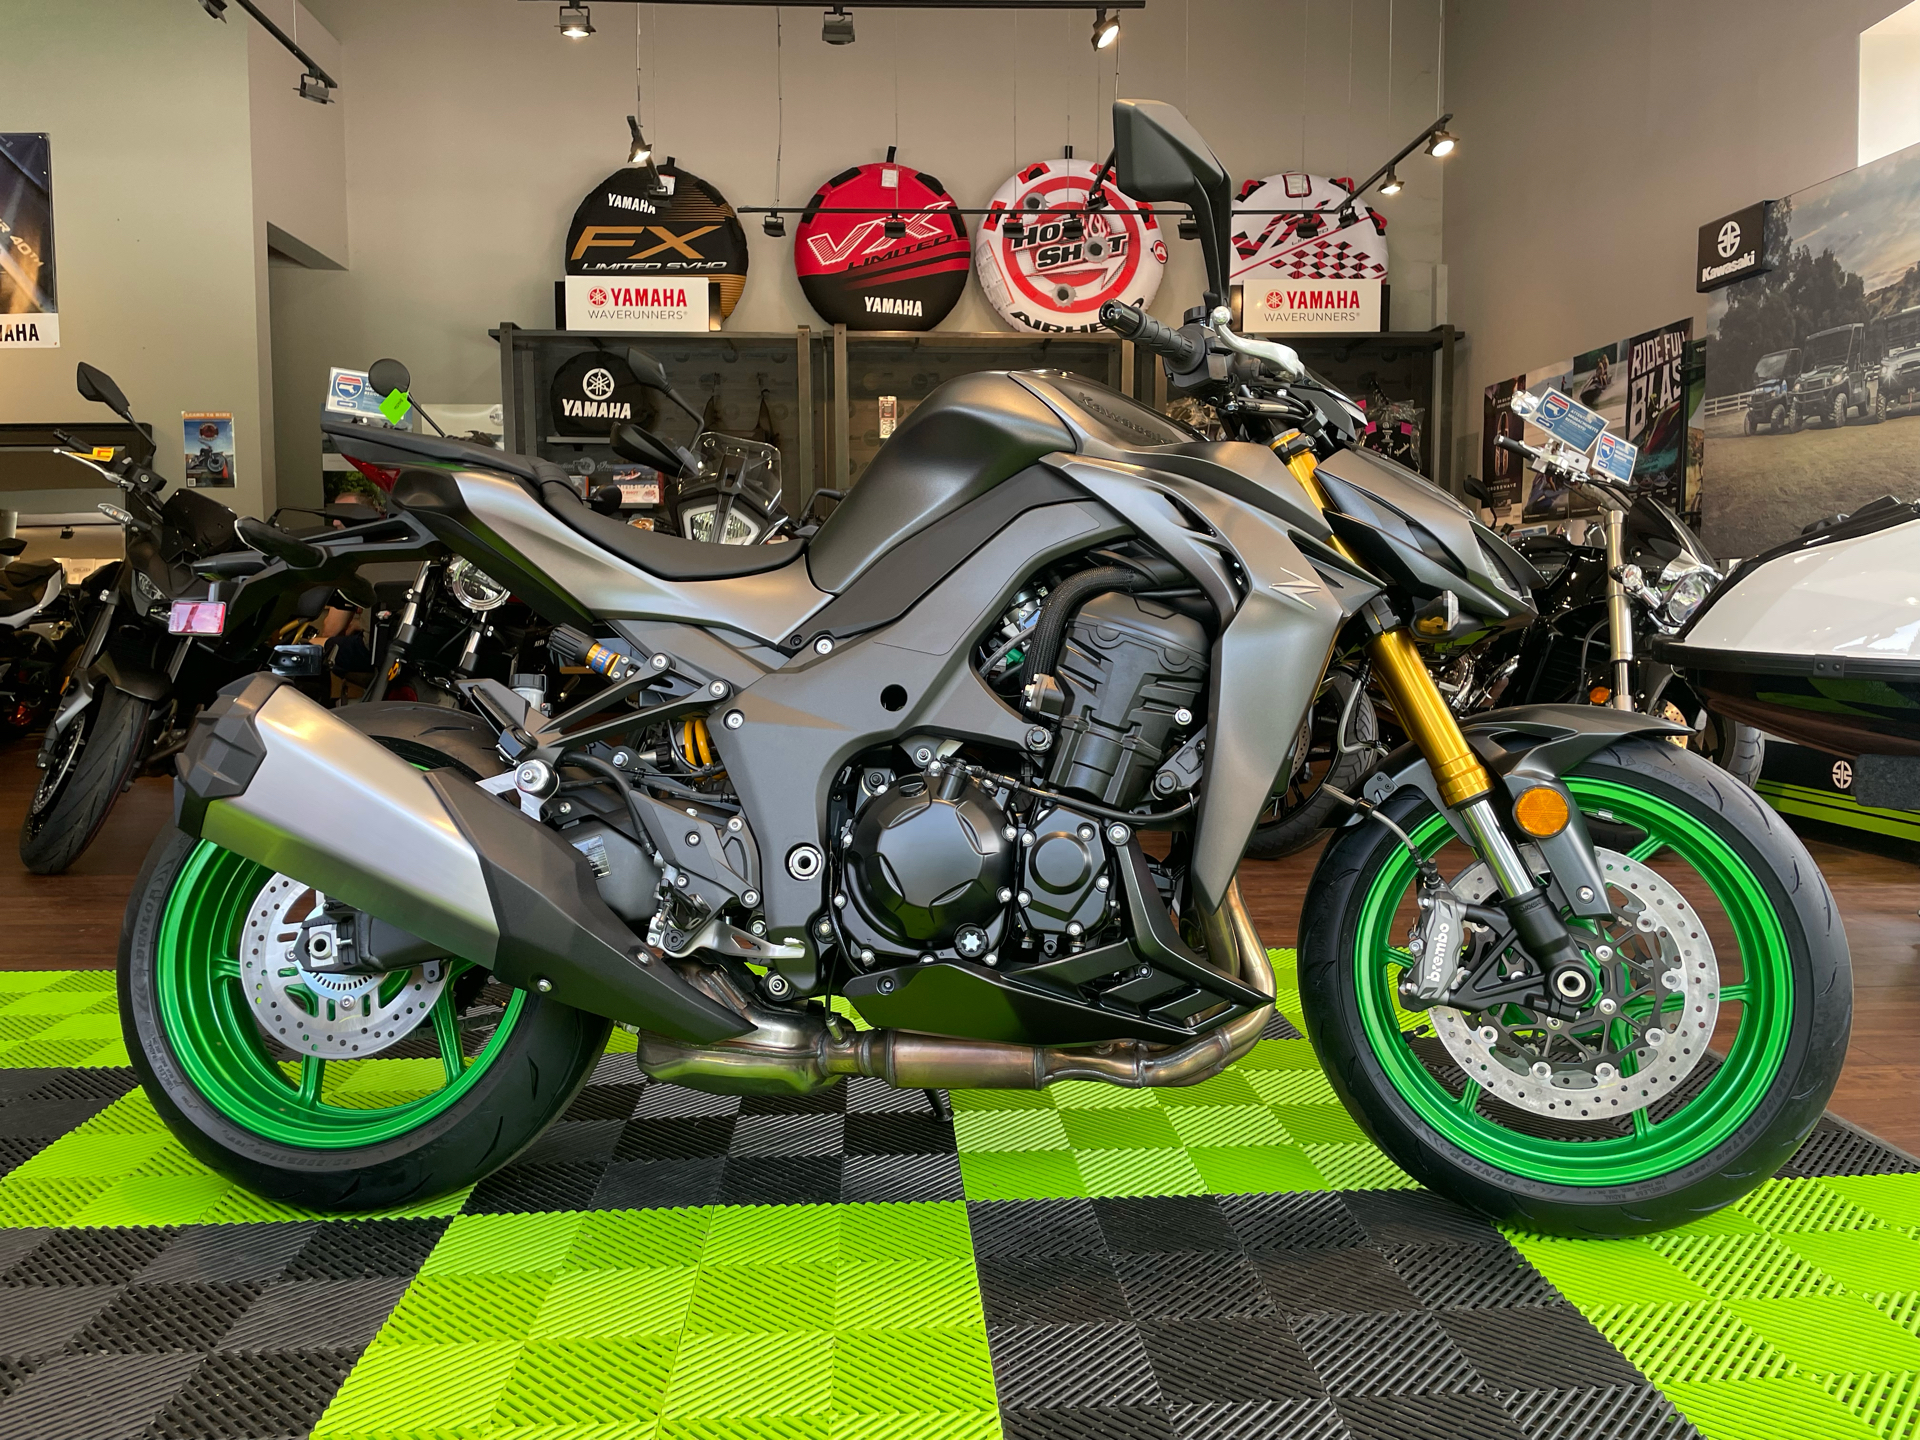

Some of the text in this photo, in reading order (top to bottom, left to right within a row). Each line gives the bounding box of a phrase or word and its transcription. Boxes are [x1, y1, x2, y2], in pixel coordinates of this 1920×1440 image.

[607, 193, 656, 214] YAMAHA
[570, 225, 722, 260] FX
[1012, 219, 1084, 249] HO
[582, 261, 728, 271] LIMITED SVHO
[848, 234, 952, 270] LIMITED
[1702, 250, 1755, 282] Kawasaki
[610, 287, 687, 307] YAMAHA
[864, 296, 923, 316] YAMAHA
[1287, 290, 1360, 309] YAMAHA
[0, 323, 40, 342] AHA
[1631, 336, 1661, 378] RIDE
[562, 398, 631, 419] YAMAHA
[1630, 357, 1681, 441] BLAS
[1426, 923, 1450, 982] brembo
[1445, 1145, 1516, 1188] DUNLOP
